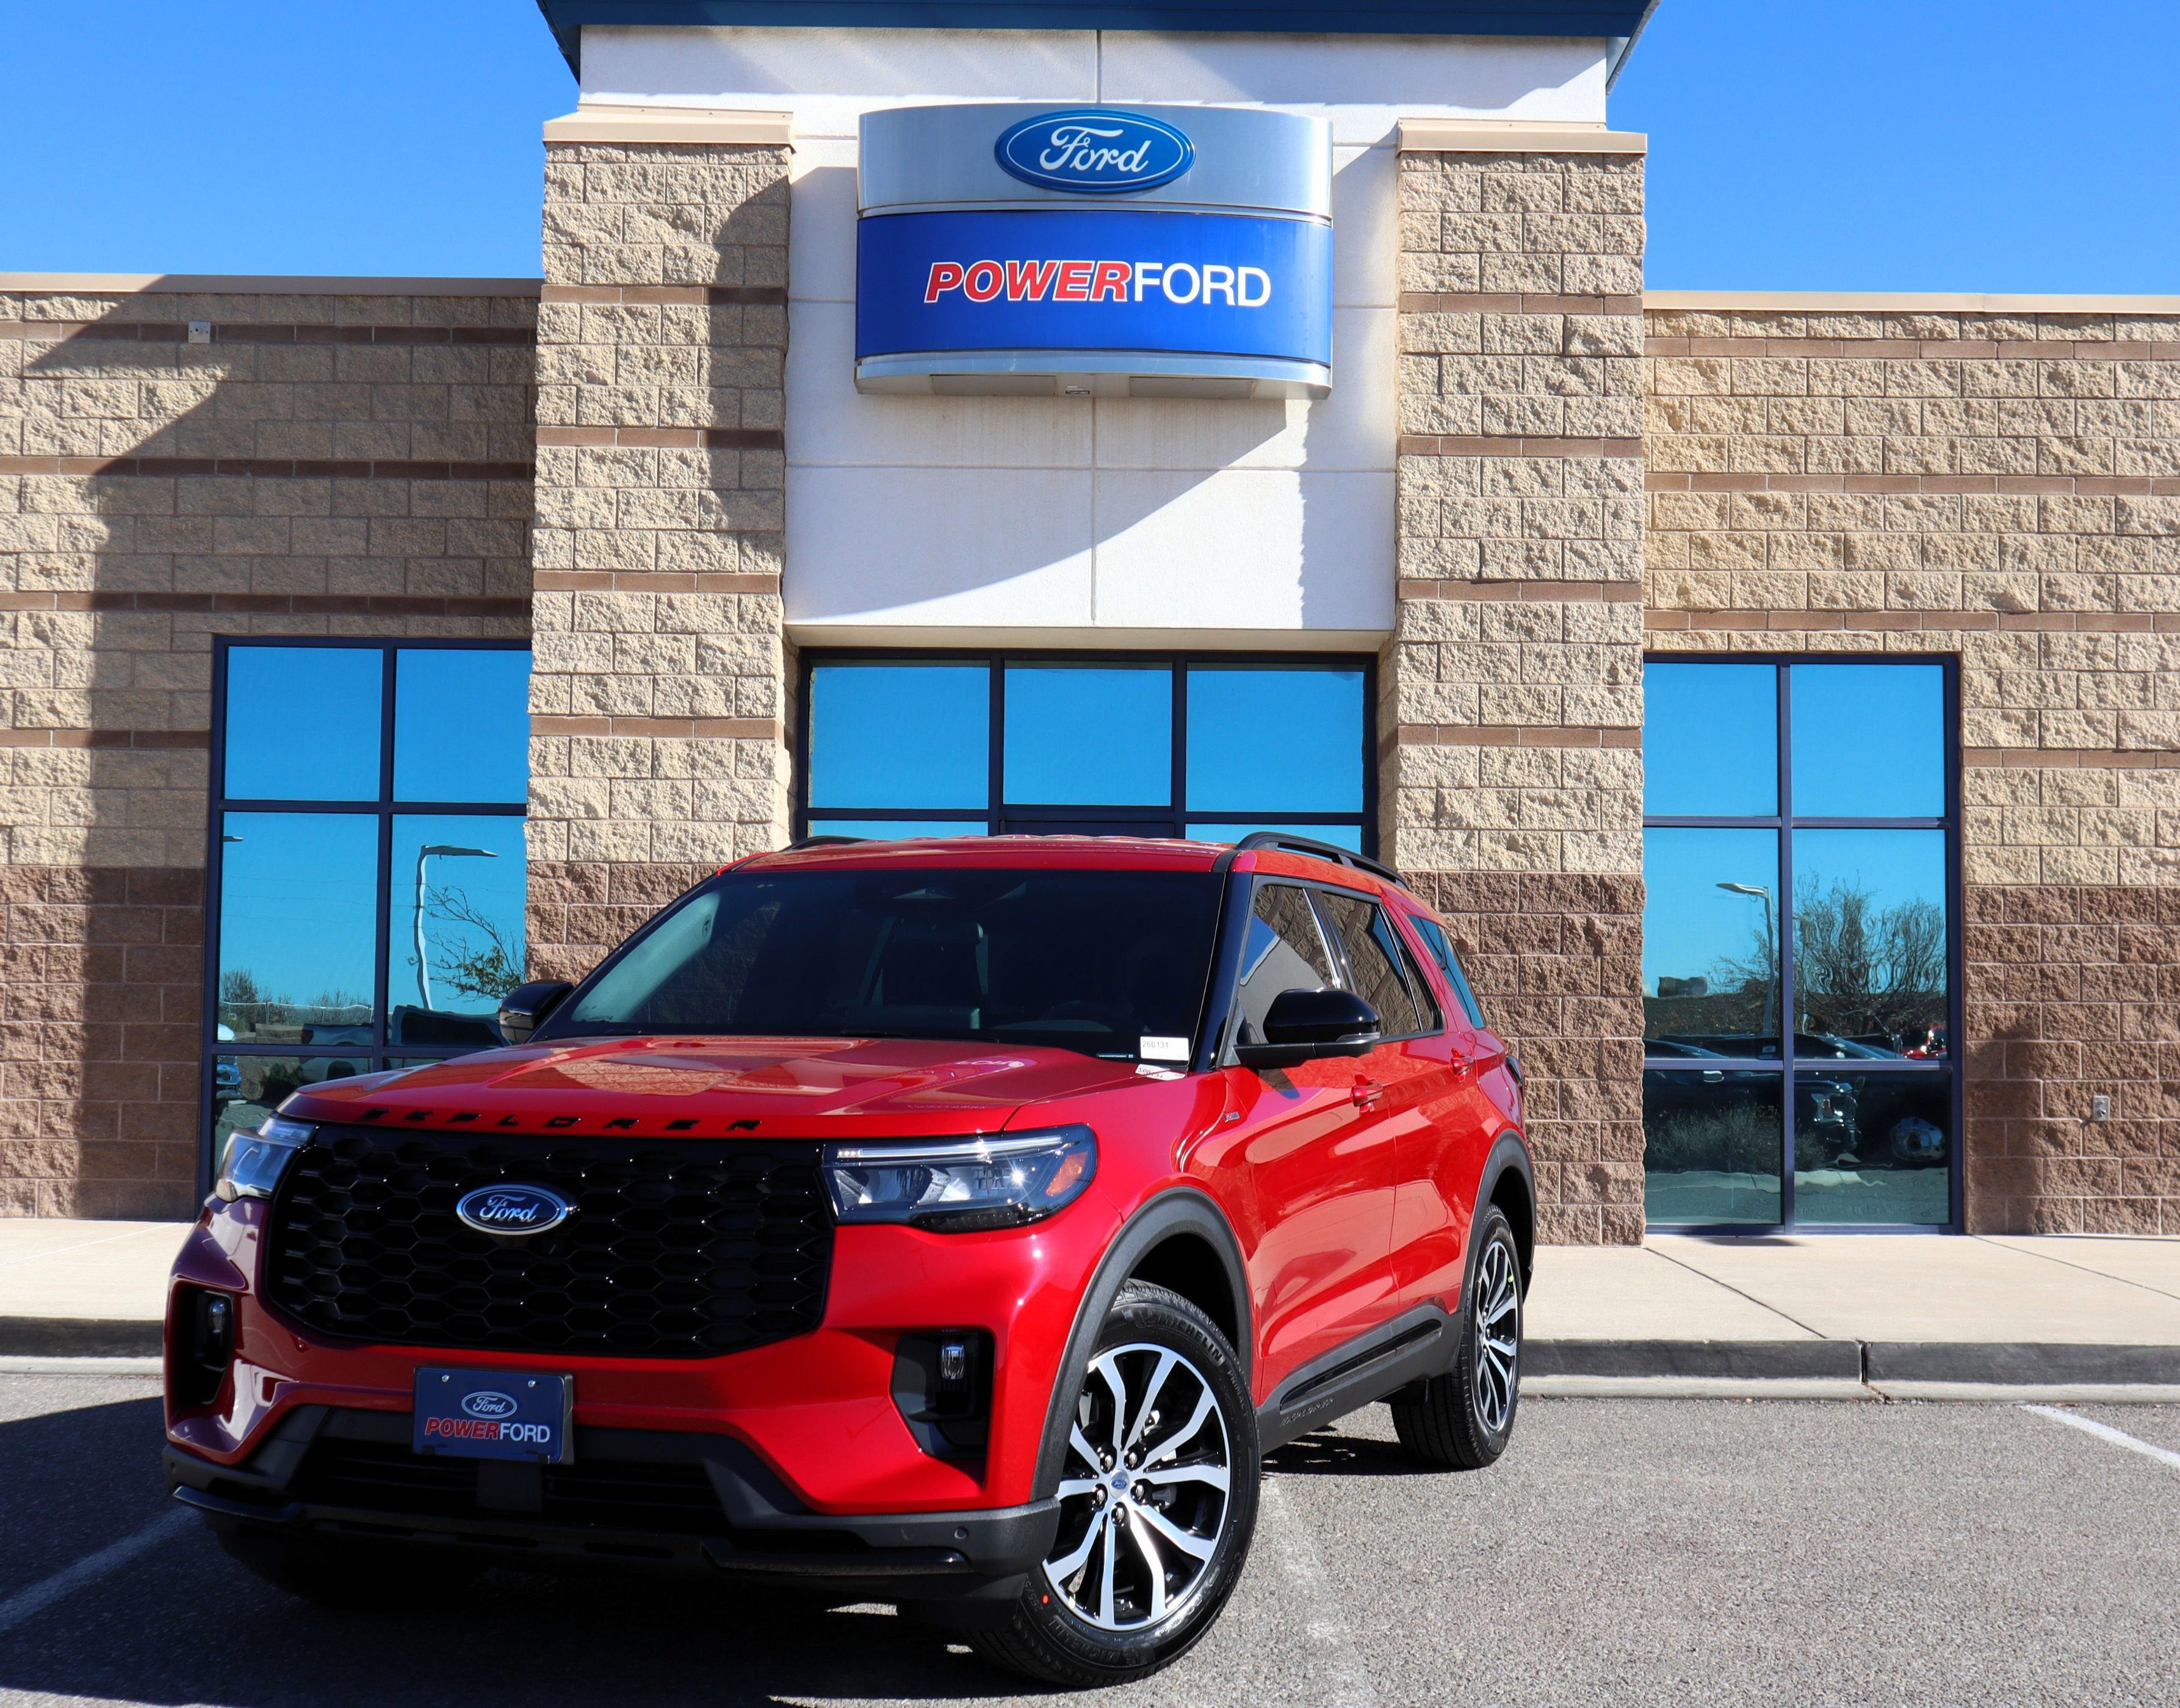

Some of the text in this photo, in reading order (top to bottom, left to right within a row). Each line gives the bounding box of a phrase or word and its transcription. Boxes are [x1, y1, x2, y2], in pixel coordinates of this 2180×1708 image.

[1039, 126, 1152, 172] Ford
[923, 260, 1272, 308] POWERFORD
[359, 1108, 762, 1131] EXPLORER
[479, 1194, 540, 1222] Ford
[1158, 1313, 1222, 1362] MICHELIN
[472, 1396, 506, 1413] Ford
[1226, 1370, 1249, 1418] PRIMACY
[425, 1417, 550, 1443] POWERFORD
